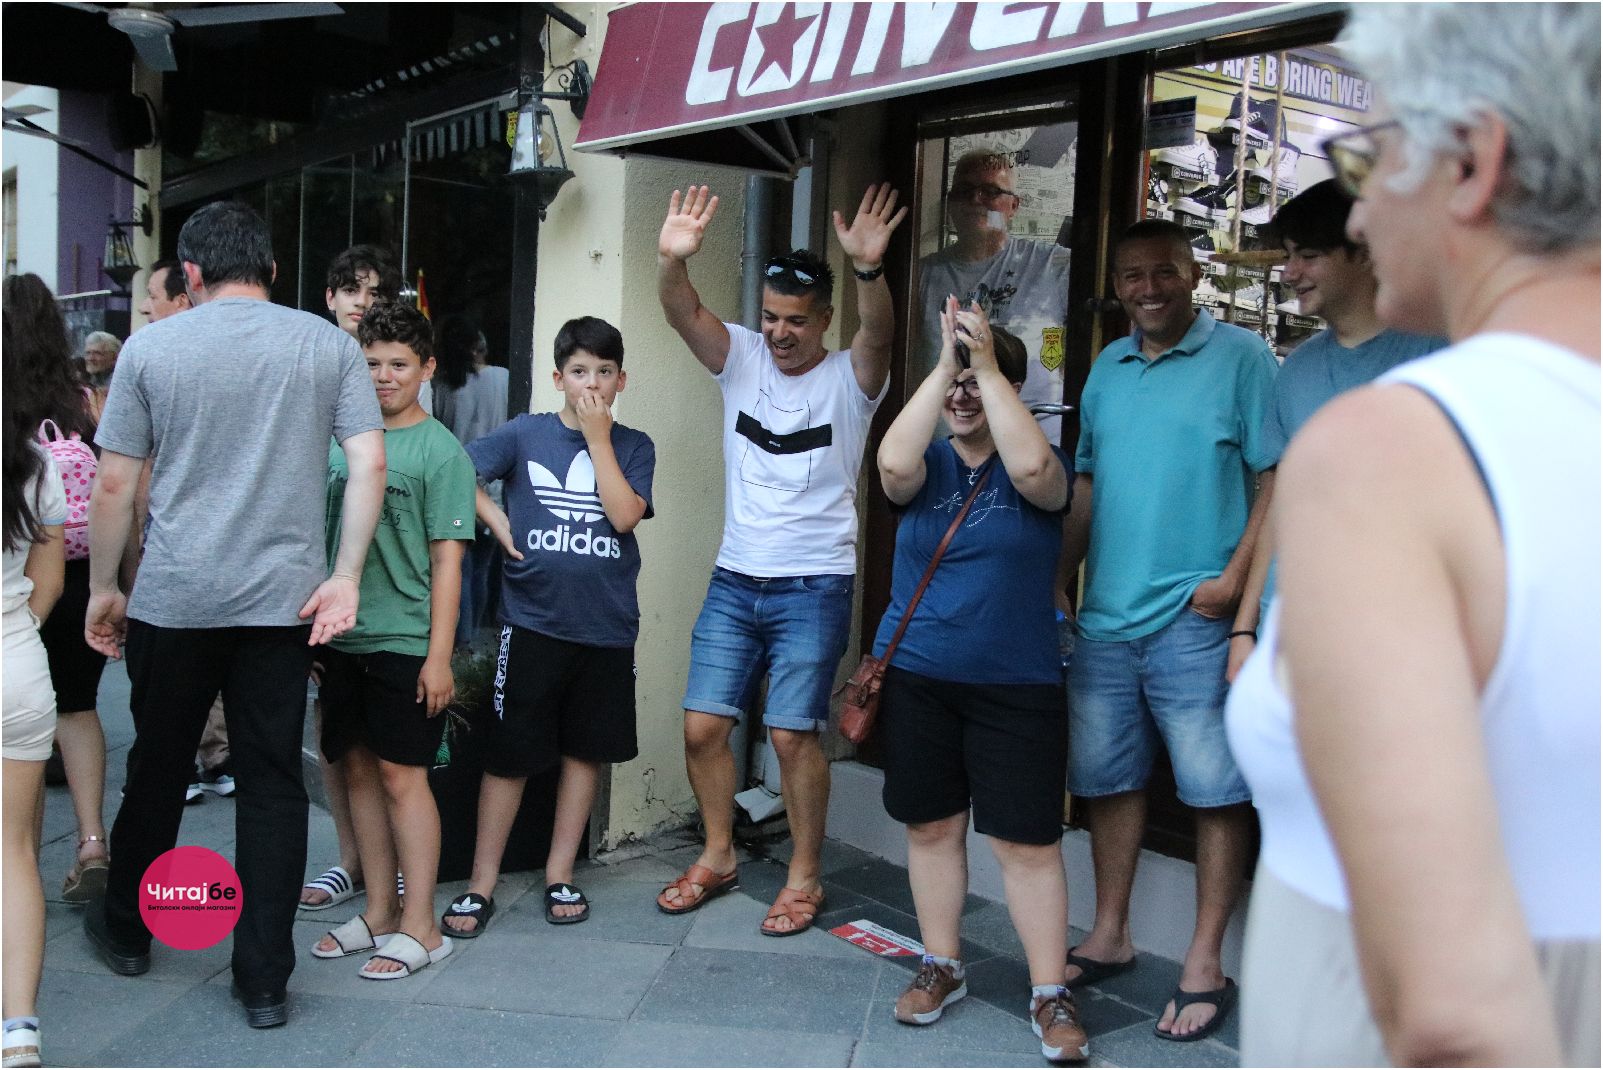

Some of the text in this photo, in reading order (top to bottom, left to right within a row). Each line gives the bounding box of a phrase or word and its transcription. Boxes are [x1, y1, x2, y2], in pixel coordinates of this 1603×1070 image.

[1264, 55, 1332, 102] BORING
[1337, 73, 1373, 110] WEA
[527, 525, 621, 559] adidas
